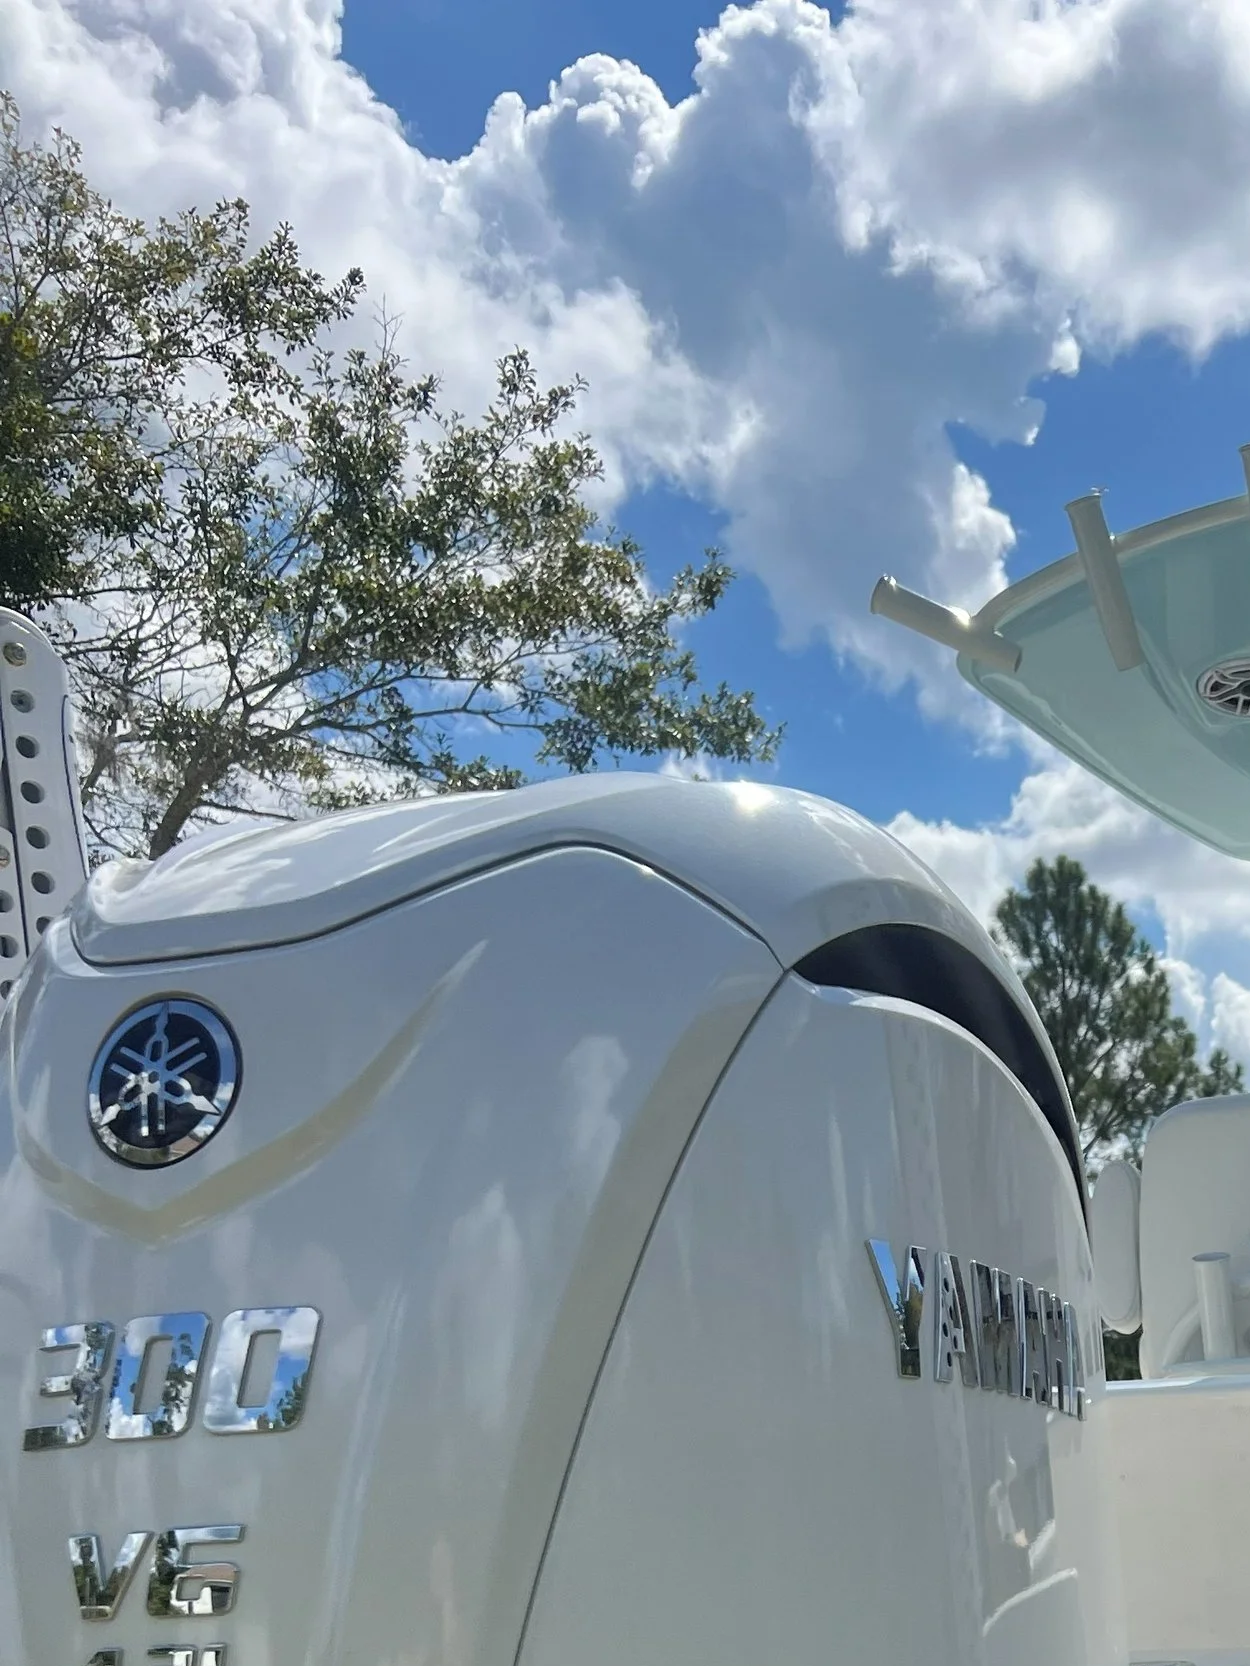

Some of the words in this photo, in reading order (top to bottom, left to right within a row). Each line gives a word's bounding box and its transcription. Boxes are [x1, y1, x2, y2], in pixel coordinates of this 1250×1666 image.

[22, 1305, 324, 1452] 300
[865, 1239, 1087, 1421] YAMAHA
[68, 1524, 247, 1622] V6
